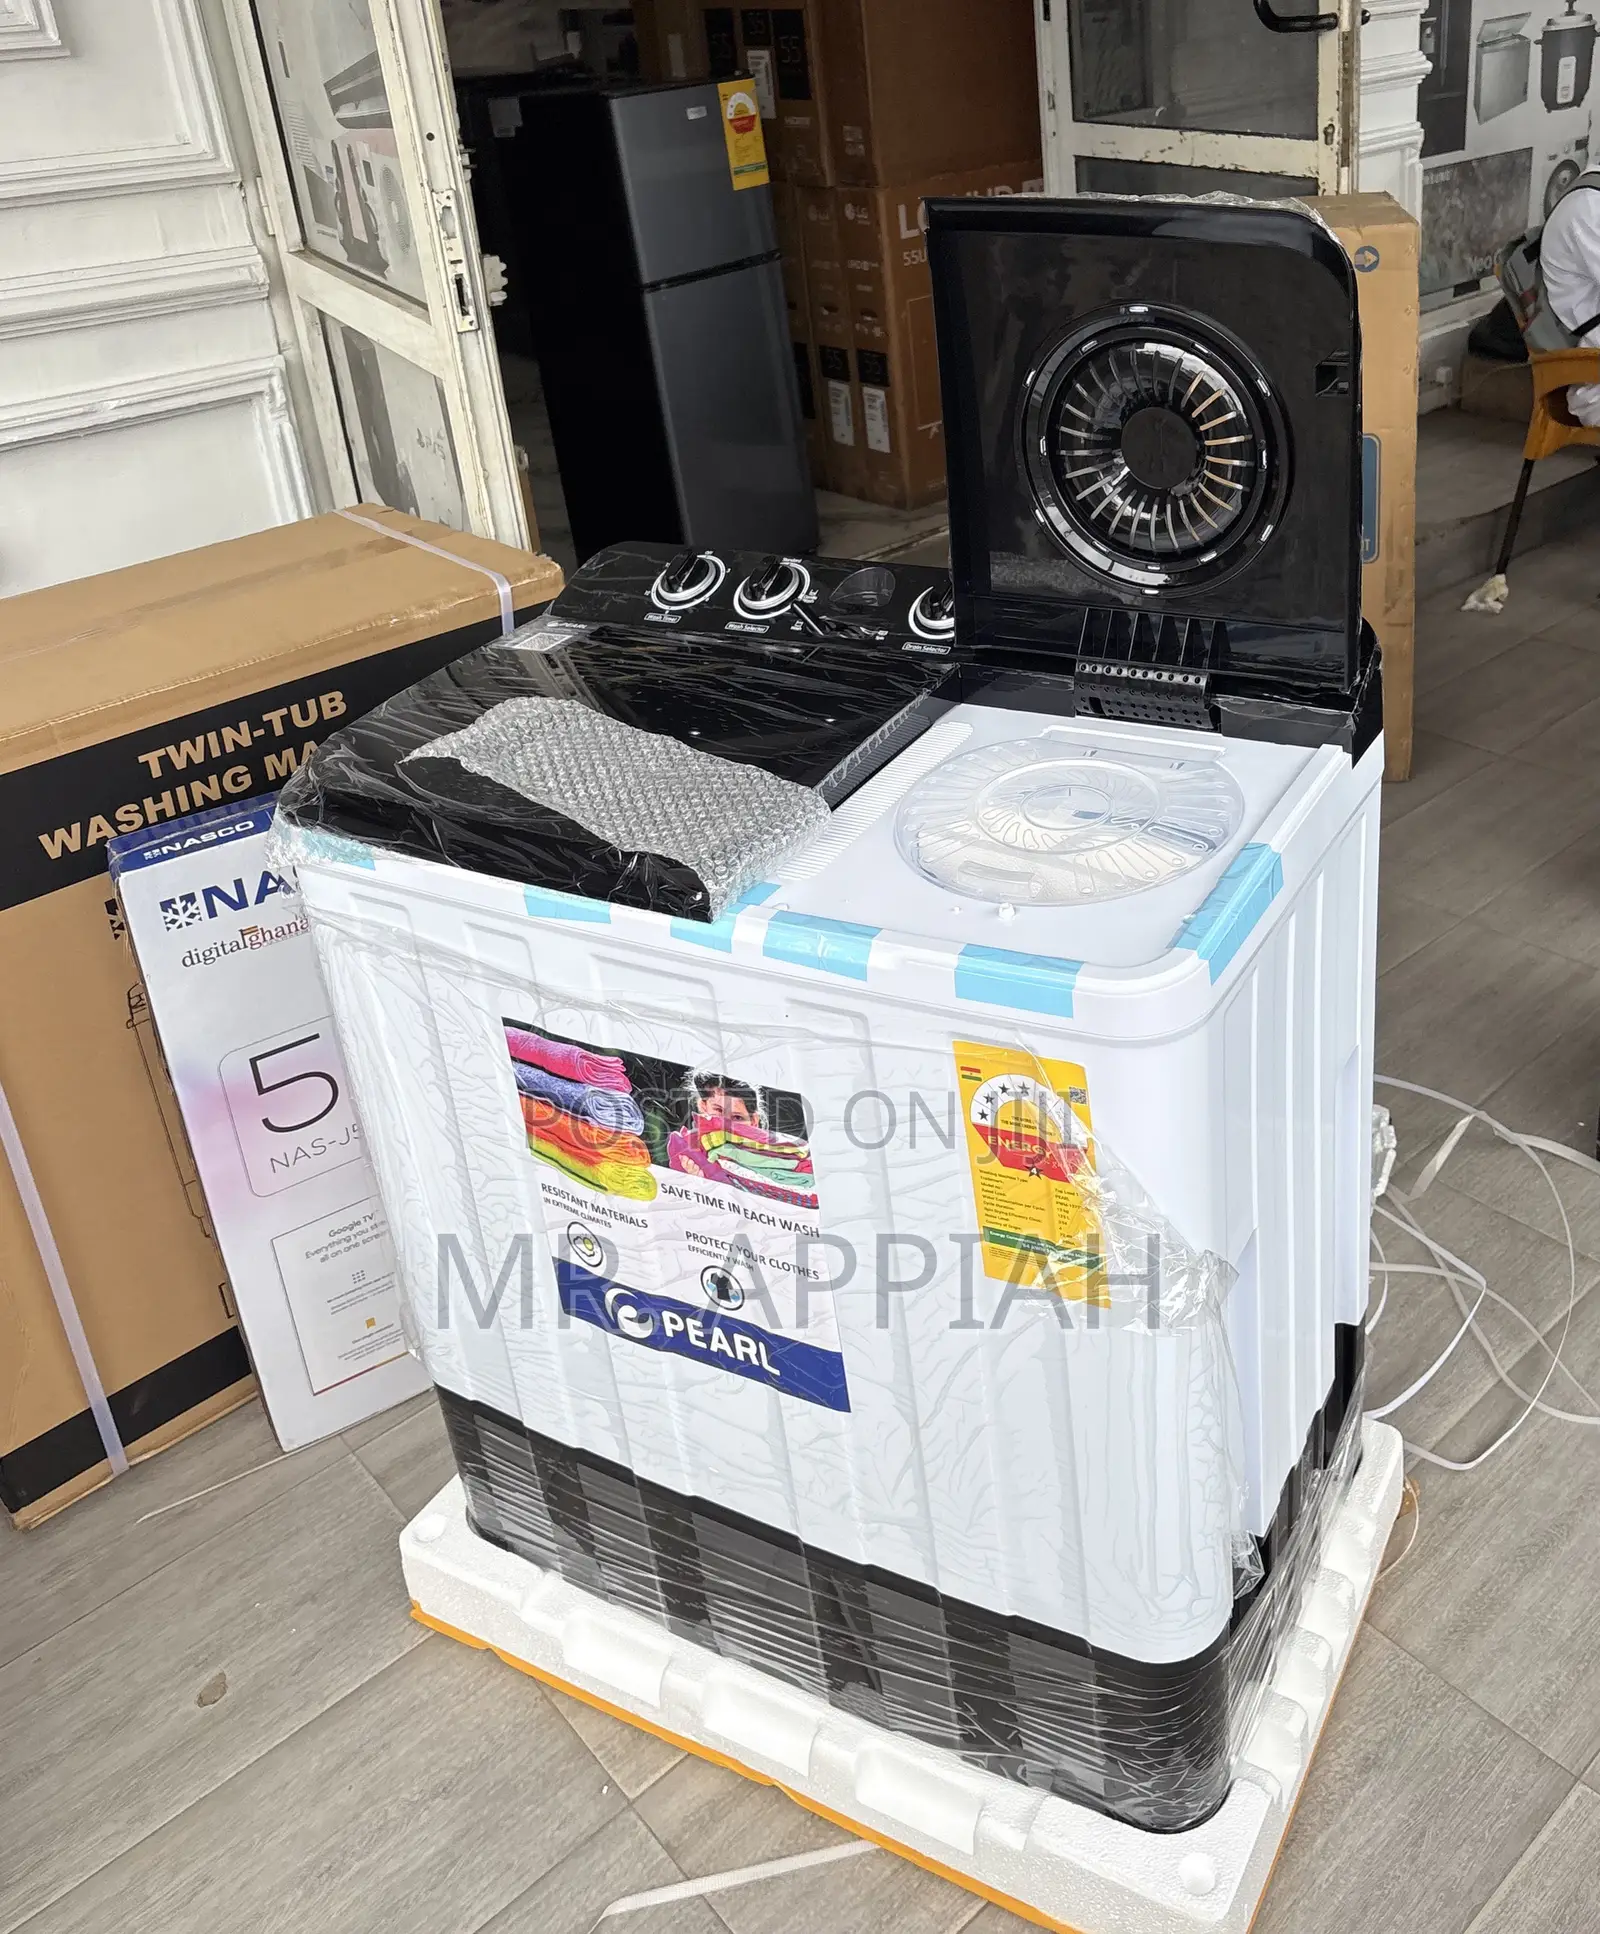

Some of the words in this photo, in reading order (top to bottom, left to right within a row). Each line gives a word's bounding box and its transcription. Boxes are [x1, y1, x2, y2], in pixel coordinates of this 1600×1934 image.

[728, 623, 744, 631] Wash
[744, 624, 767, 633] Selector
[905, 643, 922, 651] Drain
[923, 645, 948, 654] Selector
[138, 690, 347, 779] TWIN-TUB
[38, 765, 253, 860] WASHING
[162, 820, 255, 855] NASCO
[182, 917, 310, 968] digitalghana
[987, 1135, 1053, 1160] ENERGY
[1031, 1166, 1038, 1175] 4
[541, 1182, 589, 1211] RESISTANT
[590, 1202, 648, 1229] MATERIALS
[543, 1196, 552, 1205] IN
[551, 1198, 581, 1218] EXTREME
[580, 1212, 612, 1229] CLIMATES
[660, 1182, 692, 1201] SAVE
[693, 1191, 726, 1211] TIME
[728, 1200, 741, 1216] IN
[743, 1207, 776, 1228] EACH
[778, 1217, 821, 1239] WASH
[328, 1218, 362, 1238] Google
[305, 1233, 356, 1260] Everything
[685, 1230, 734, 1253] PROTECT
[735, 1243, 768, 1266] YOUR
[768, 1257, 820, 1281] CLOTHES
[687, 1244, 732, 1266] EFFICIENTLY
[731, 1256, 755, 1273] WASH
[661, 1309, 781, 1377] PEARL
